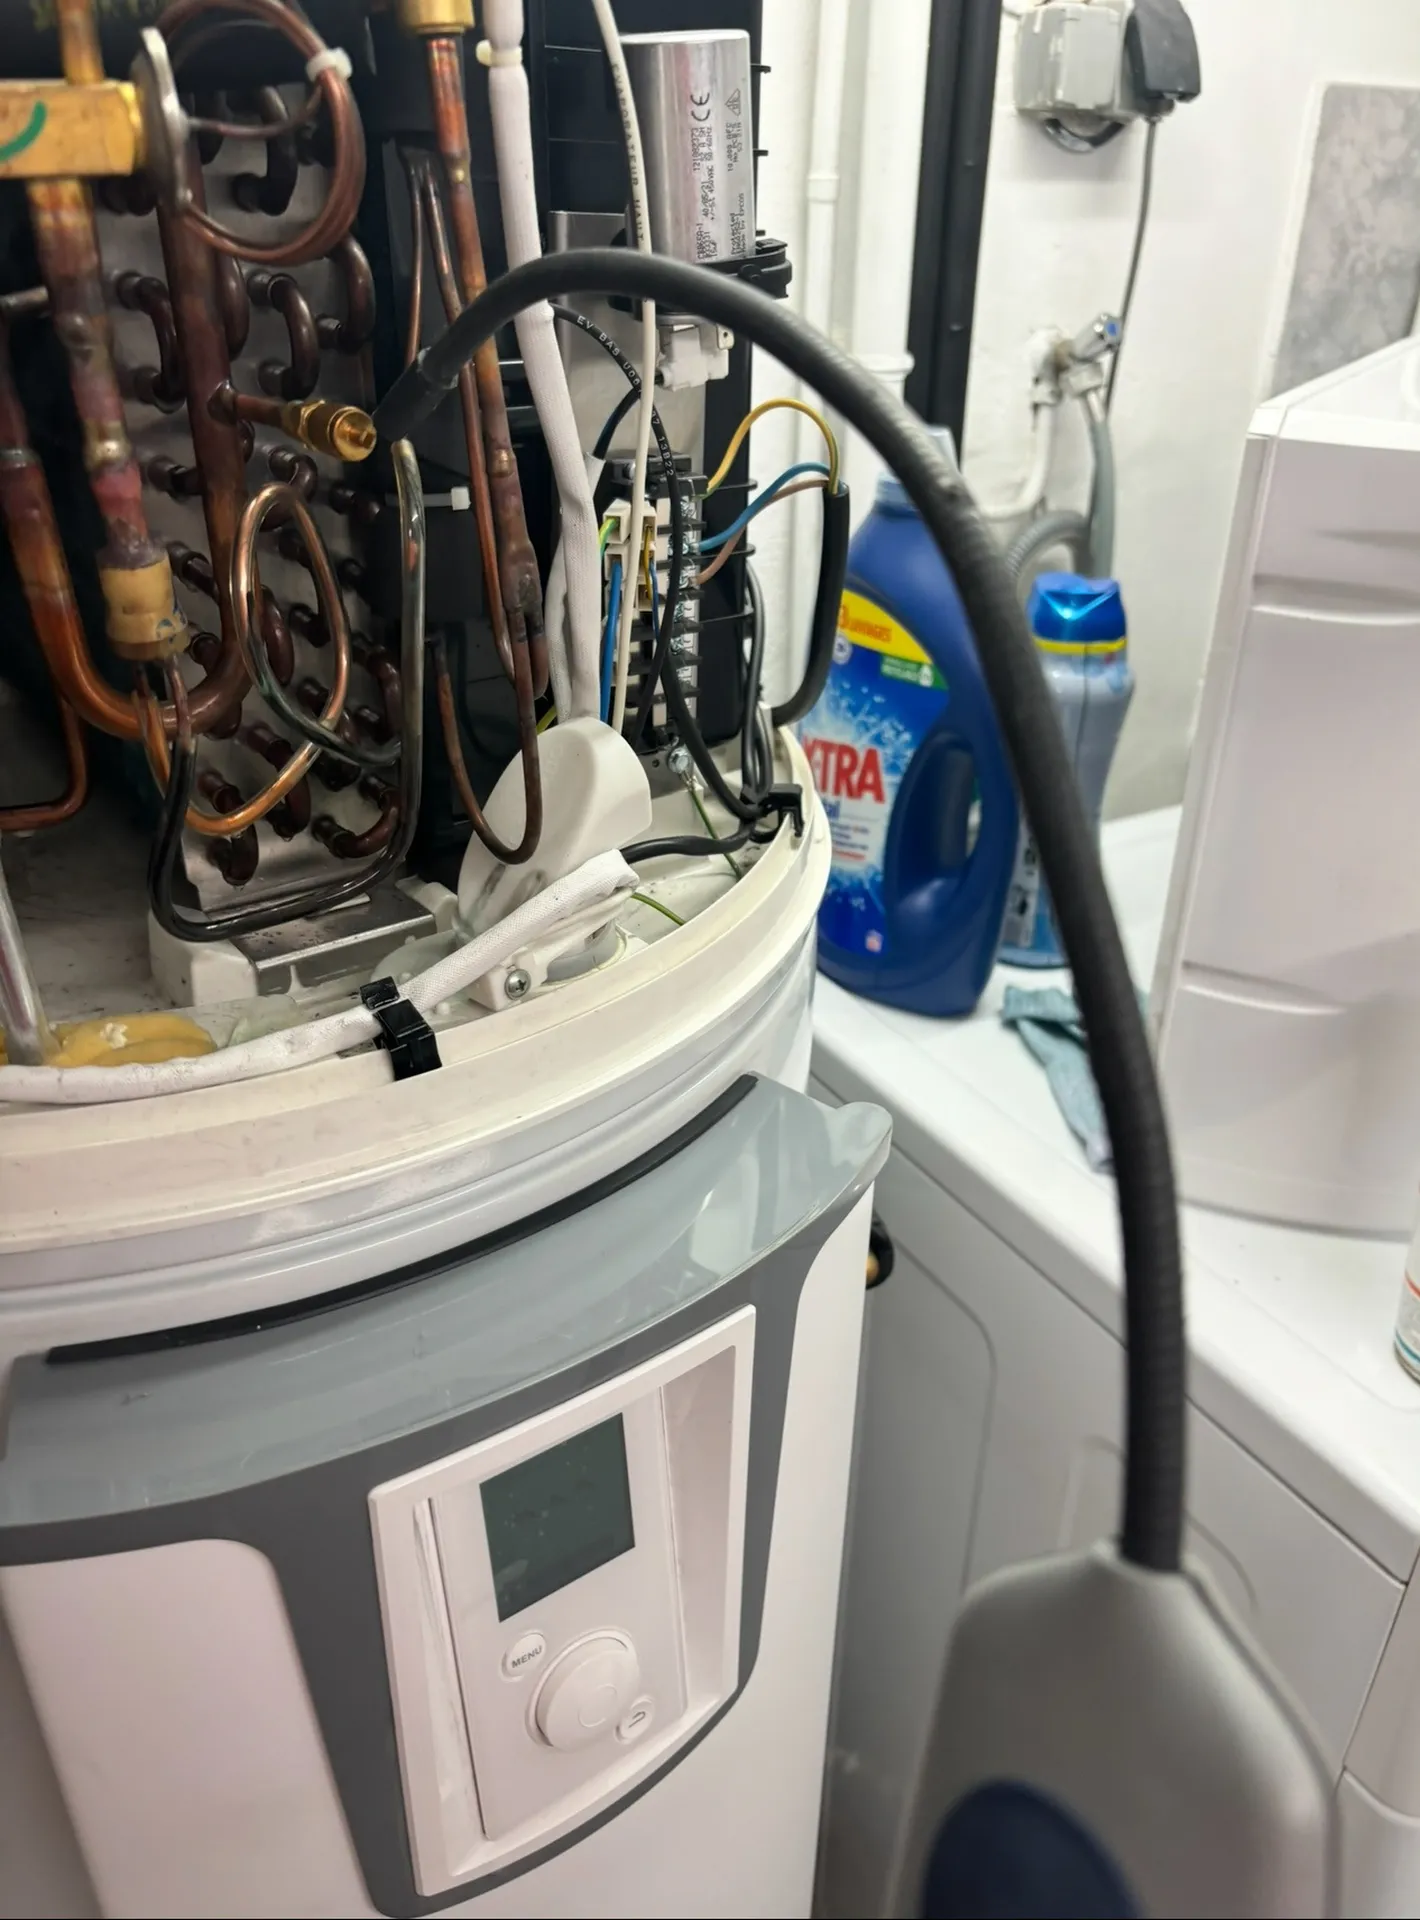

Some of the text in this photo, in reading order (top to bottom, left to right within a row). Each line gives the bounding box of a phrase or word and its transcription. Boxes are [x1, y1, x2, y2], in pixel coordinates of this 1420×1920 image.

[577, 315, 594, 329] EV
[599, 332, 621, 357] BAS
[511, 1645, 542, 1669] MENU
